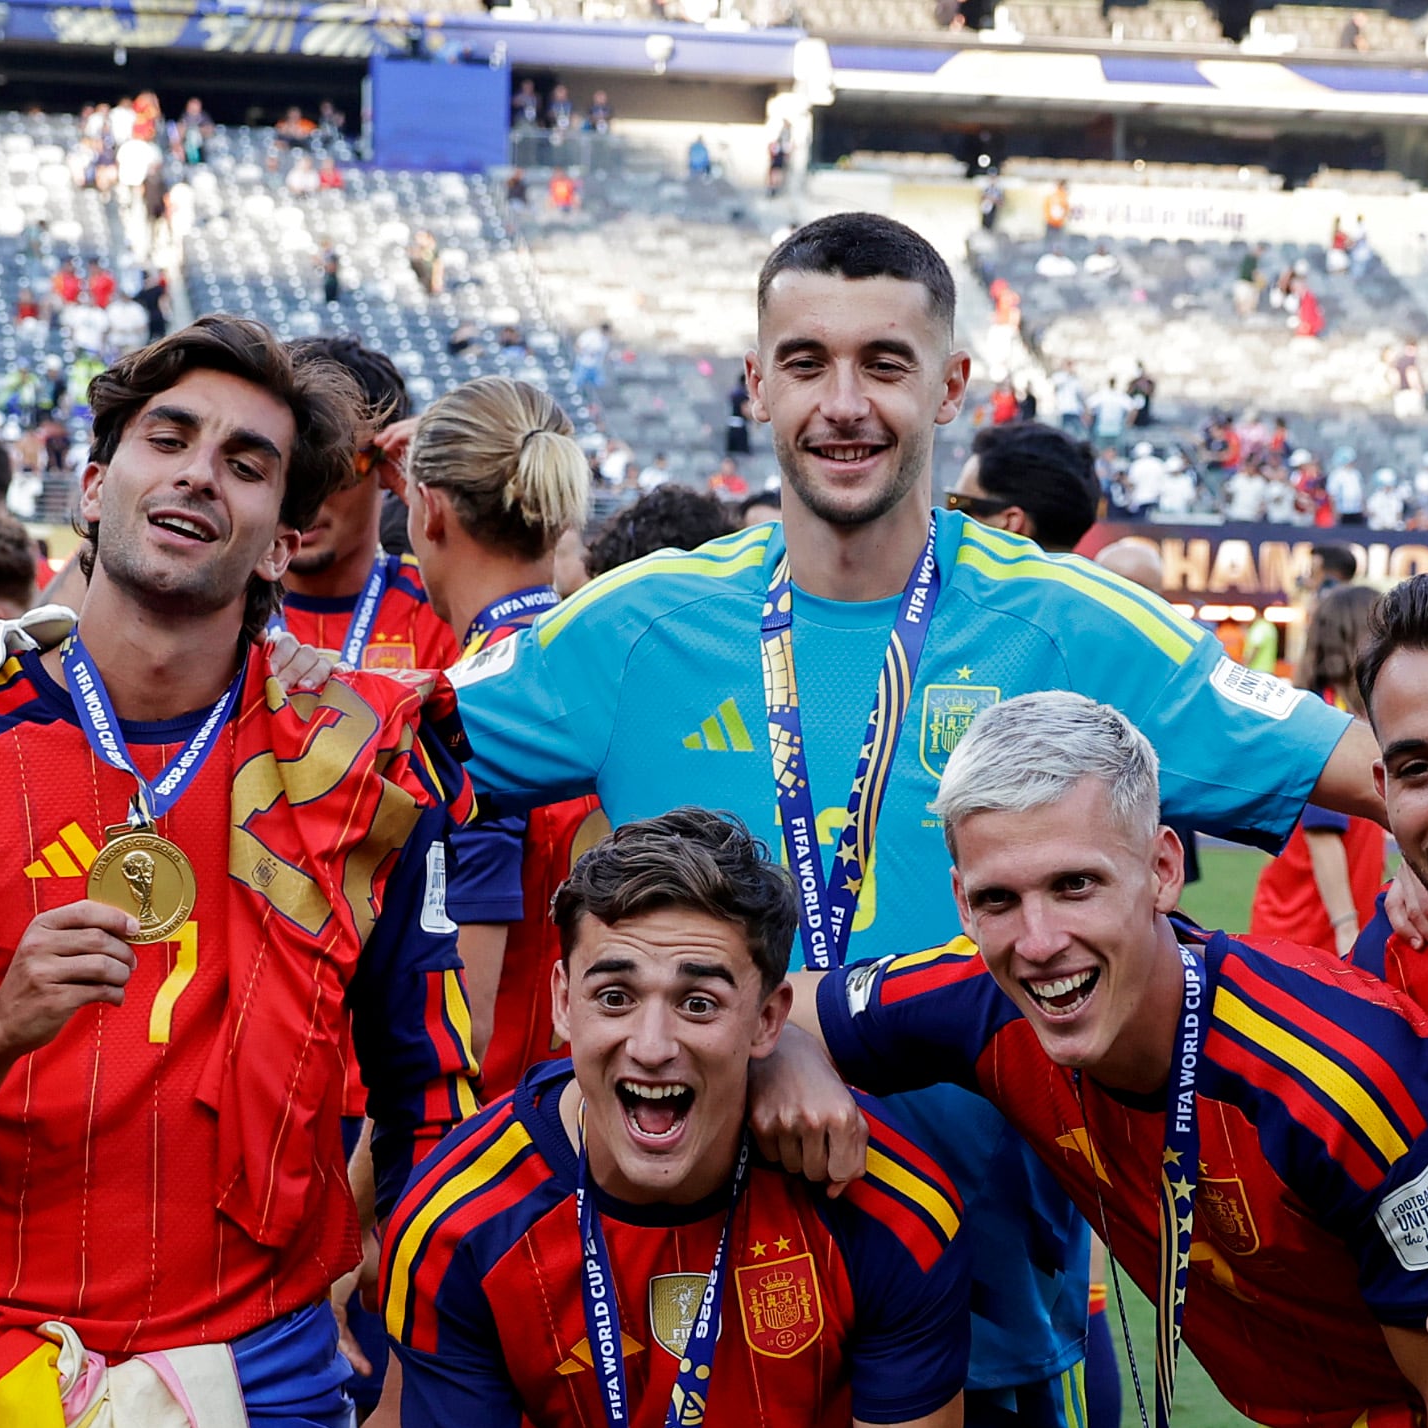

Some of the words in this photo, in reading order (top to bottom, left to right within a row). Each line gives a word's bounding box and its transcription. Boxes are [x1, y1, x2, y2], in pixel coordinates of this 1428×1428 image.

[490, 600, 523, 620] FIFA
[906, 587, 928, 623] FIFA
[72, 661, 94, 695] FIFA
[84, 694, 110, 732] WORLD
[98, 728, 119, 754] CUP
[154, 766, 183, 797] 2026
[176, 748, 199, 778] CUP
[792, 817, 811, 859] FIFA
[798, 859, 823, 929] WORLD
[811, 930, 829, 968] CUP
[149, 921, 198, 1043] 7
[1185, 972, 1202, 1010] CUP
[1179, 1013, 1200, 1088] WORLD
[1175, 1090, 1194, 1133] FIFA
[1401, 1231, 1424, 1248] the
[587, 1260, 608, 1299] CUP
[695, 1269, 718, 1339] 2026
[593, 1301, 618, 1375] WORLD
[603, 1377, 624, 1420] FIFA
